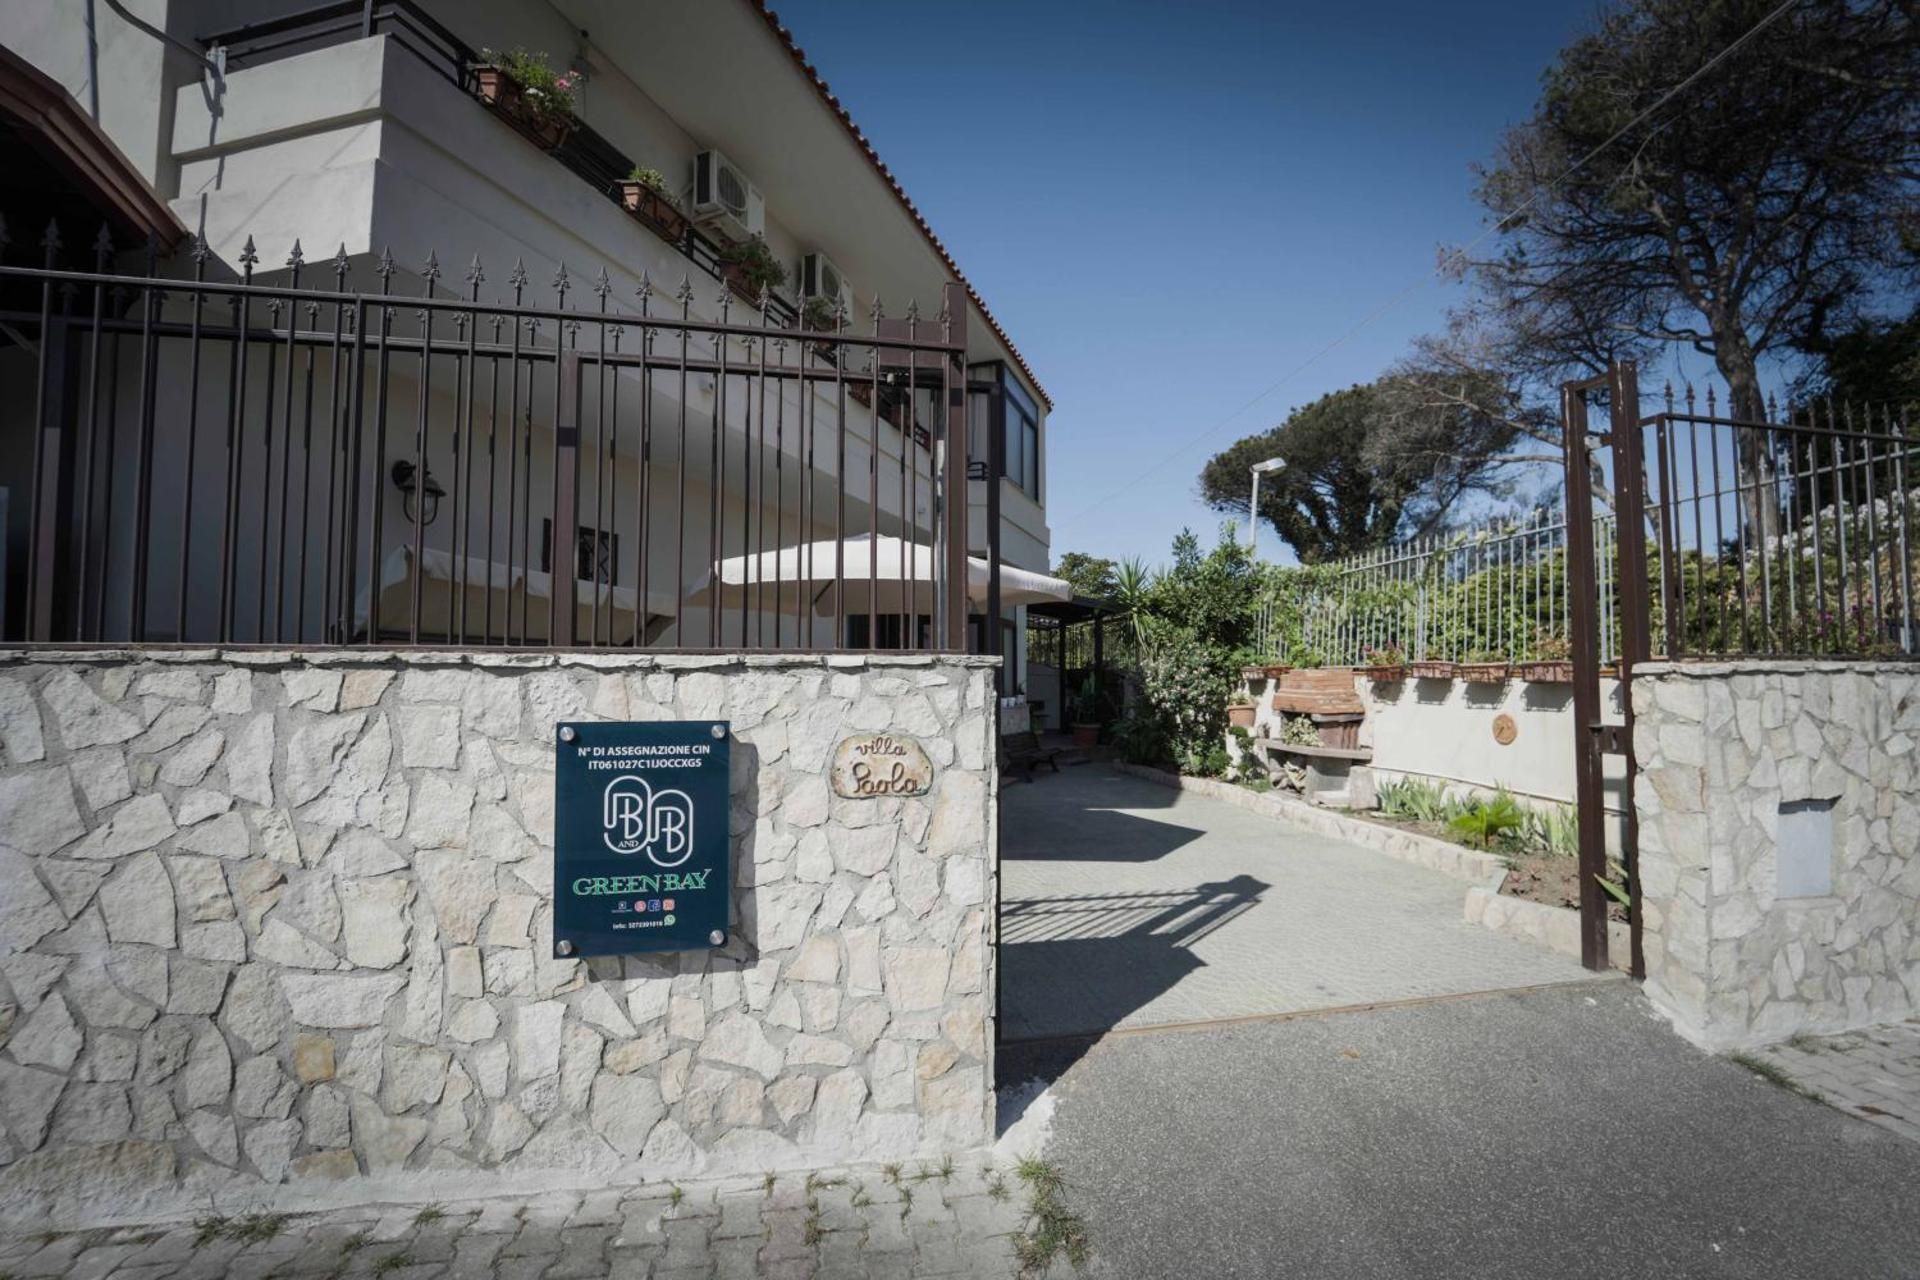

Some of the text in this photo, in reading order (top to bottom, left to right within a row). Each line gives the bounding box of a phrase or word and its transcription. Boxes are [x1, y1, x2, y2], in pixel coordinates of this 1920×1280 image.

[593, 747, 605, 756] DI
[607, 746, 690, 756] ASSEGNAZIONE
[692, 745, 710, 754] CIN
[852, 761, 922, 794] Paola
[618, 840, 639, 848] AND
[572, 868, 712, 896] GREEN BAY
